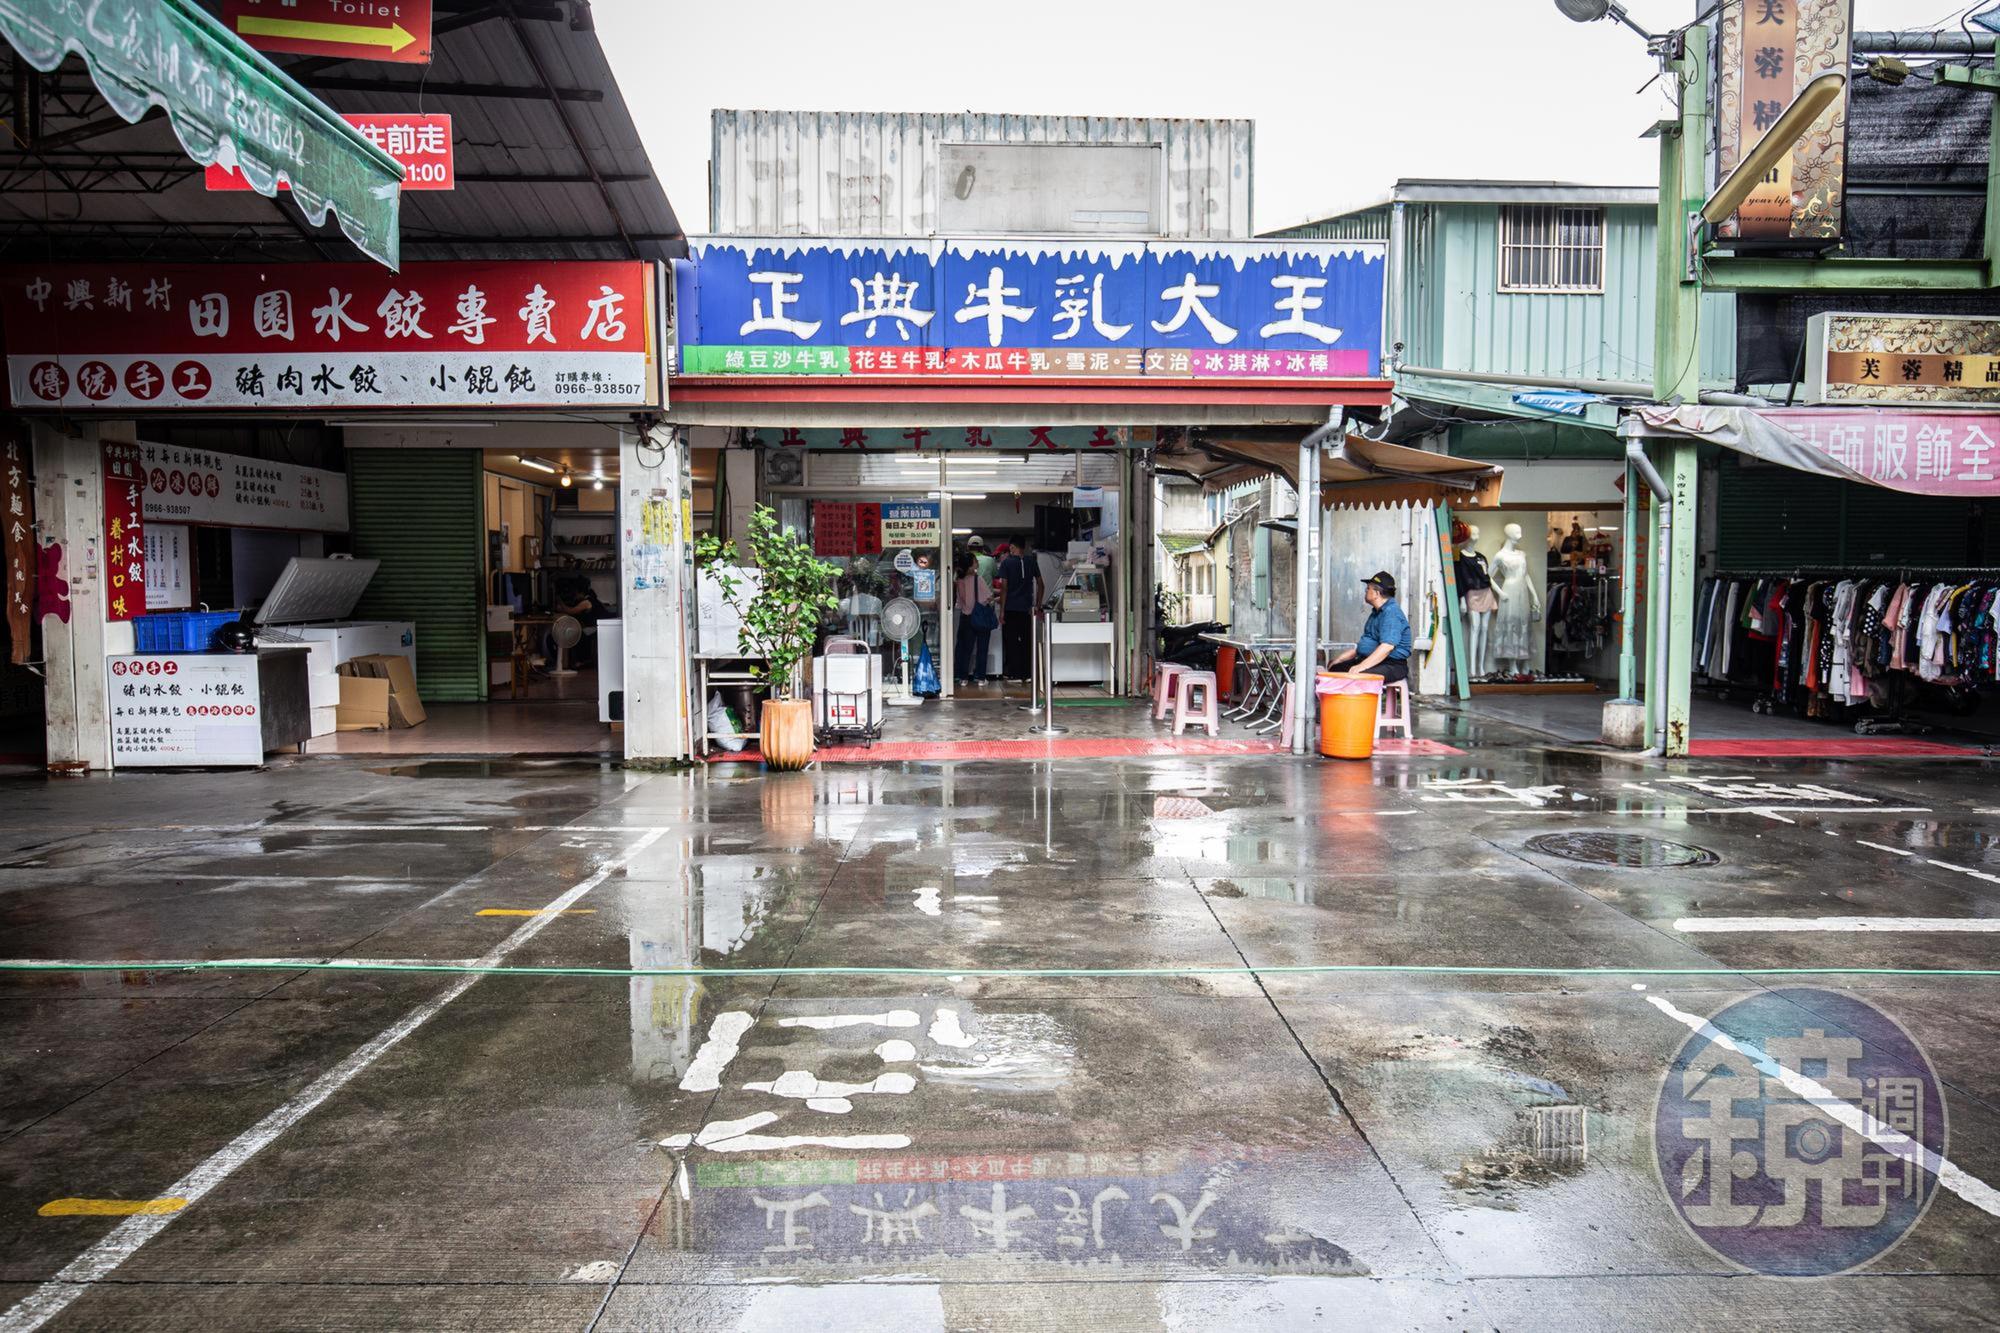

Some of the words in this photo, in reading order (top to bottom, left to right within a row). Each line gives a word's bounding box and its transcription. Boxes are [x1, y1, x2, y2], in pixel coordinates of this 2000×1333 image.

[331, 0, 401, 17] Toilet
[358, 124, 447, 155] 往前走
[1774, 195, 1791, 208] life
[26, 277, 172, 311] 中興新村
[189, 284, 628, 345] 田園水餃專賣店
[740, 267, 1343, 347] 正典牛乳大王
[32, 362, 208, 399] 傳統手工
[235, 363, 536, 397] 豬肉水餃、小餛飩
[1860, 358, 2000, 382] 芙蓉精品
[555, 383, 641, 395] 0966-938507
[6, 441, 27, 543] 北方麵食
[145, 503, 191, 515] 0966-938507
[126, 484, 144, 583] 手工水餃
[109, 516, 129, 618] 眷村口味
[112, 661, 179, 676] 傳統手工
[123, 683, 245, 697] 豬肉水餃、小餛飩
